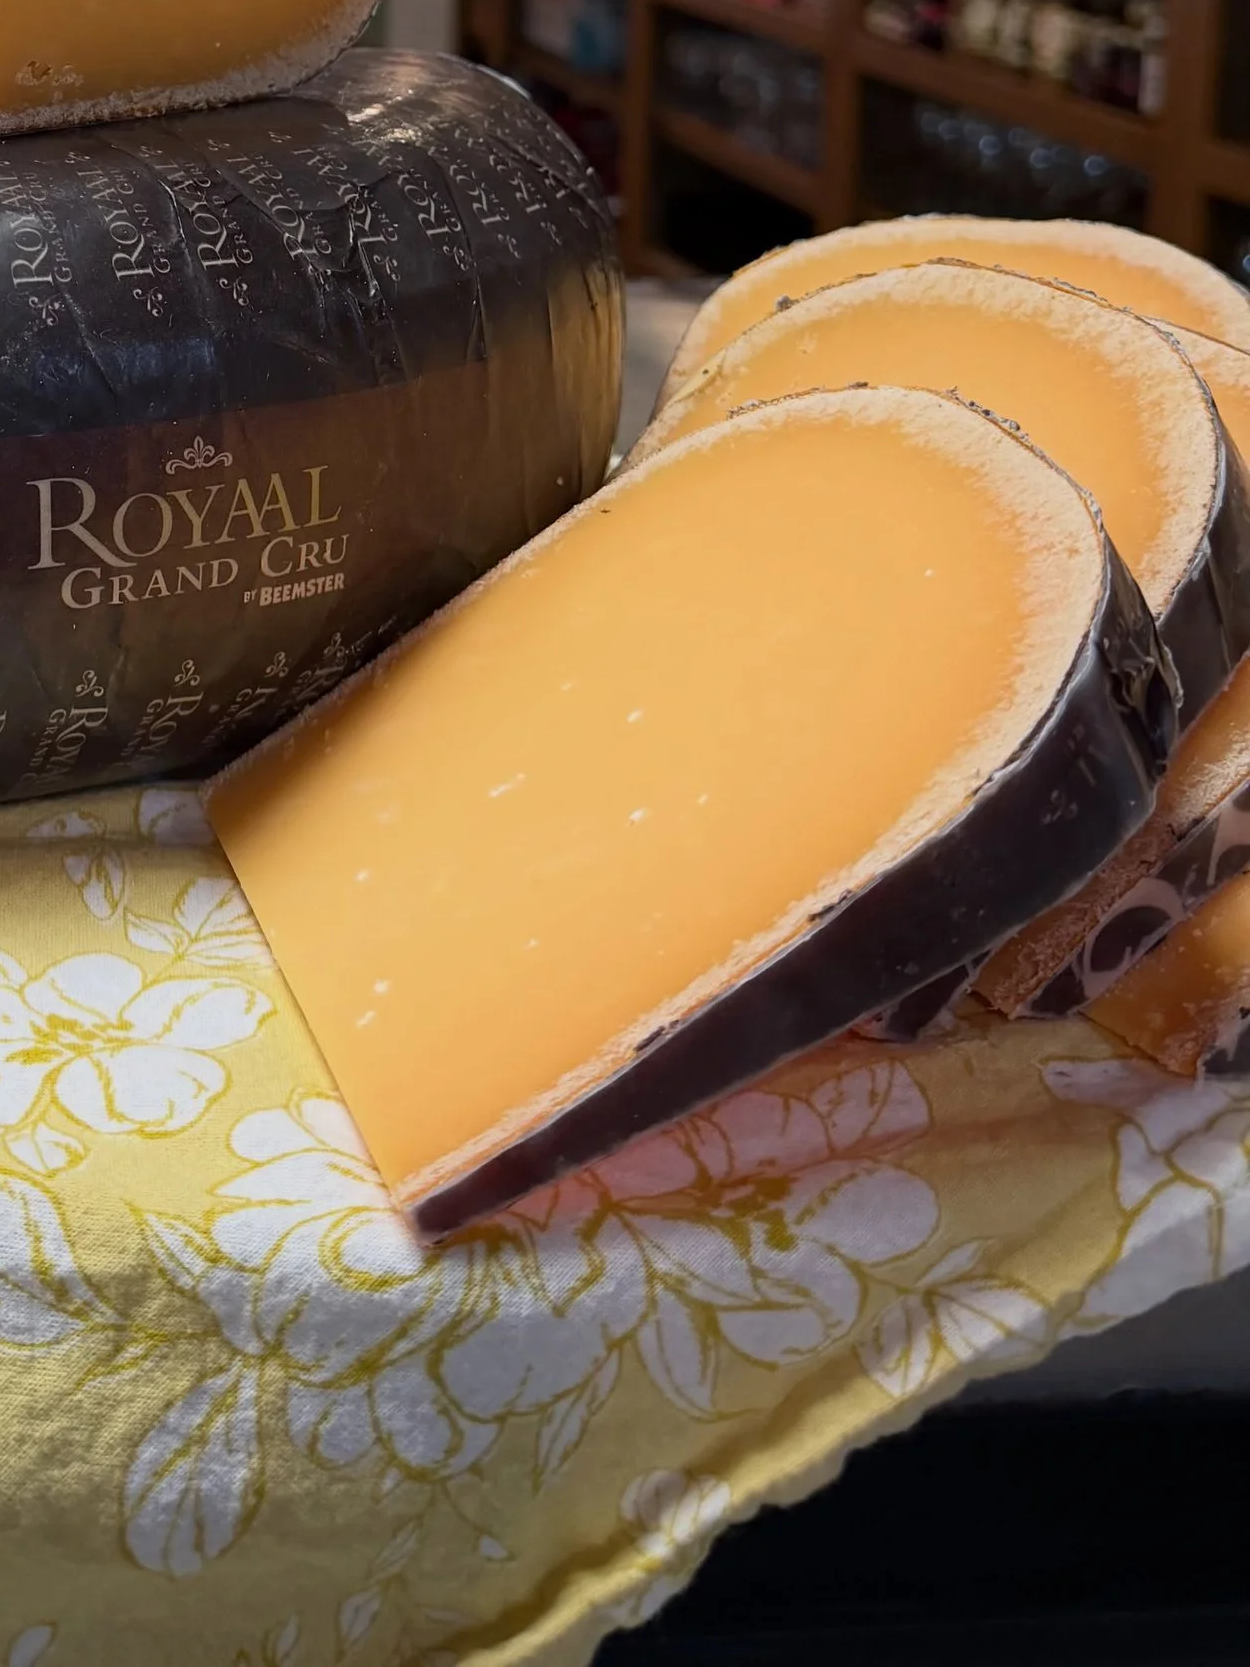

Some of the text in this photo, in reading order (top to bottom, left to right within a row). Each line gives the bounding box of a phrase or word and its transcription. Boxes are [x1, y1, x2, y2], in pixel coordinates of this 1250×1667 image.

[78, 169, 155, 282] ROYAAL
[110, 168, 171, 274] GRAND CRU
[154, 159, 238, 272] ROYAAL
[212, 195, 254, 265] GRAND
[226, 155, 319, 261] ROYAAL
[25, 464, 343, 570] ROYAAL
[60, 533, 350, 609] GRAND CRU
[243, 572, 346, 607] BY BEEMSTER
[28, 708, 68, 767] GRAND
